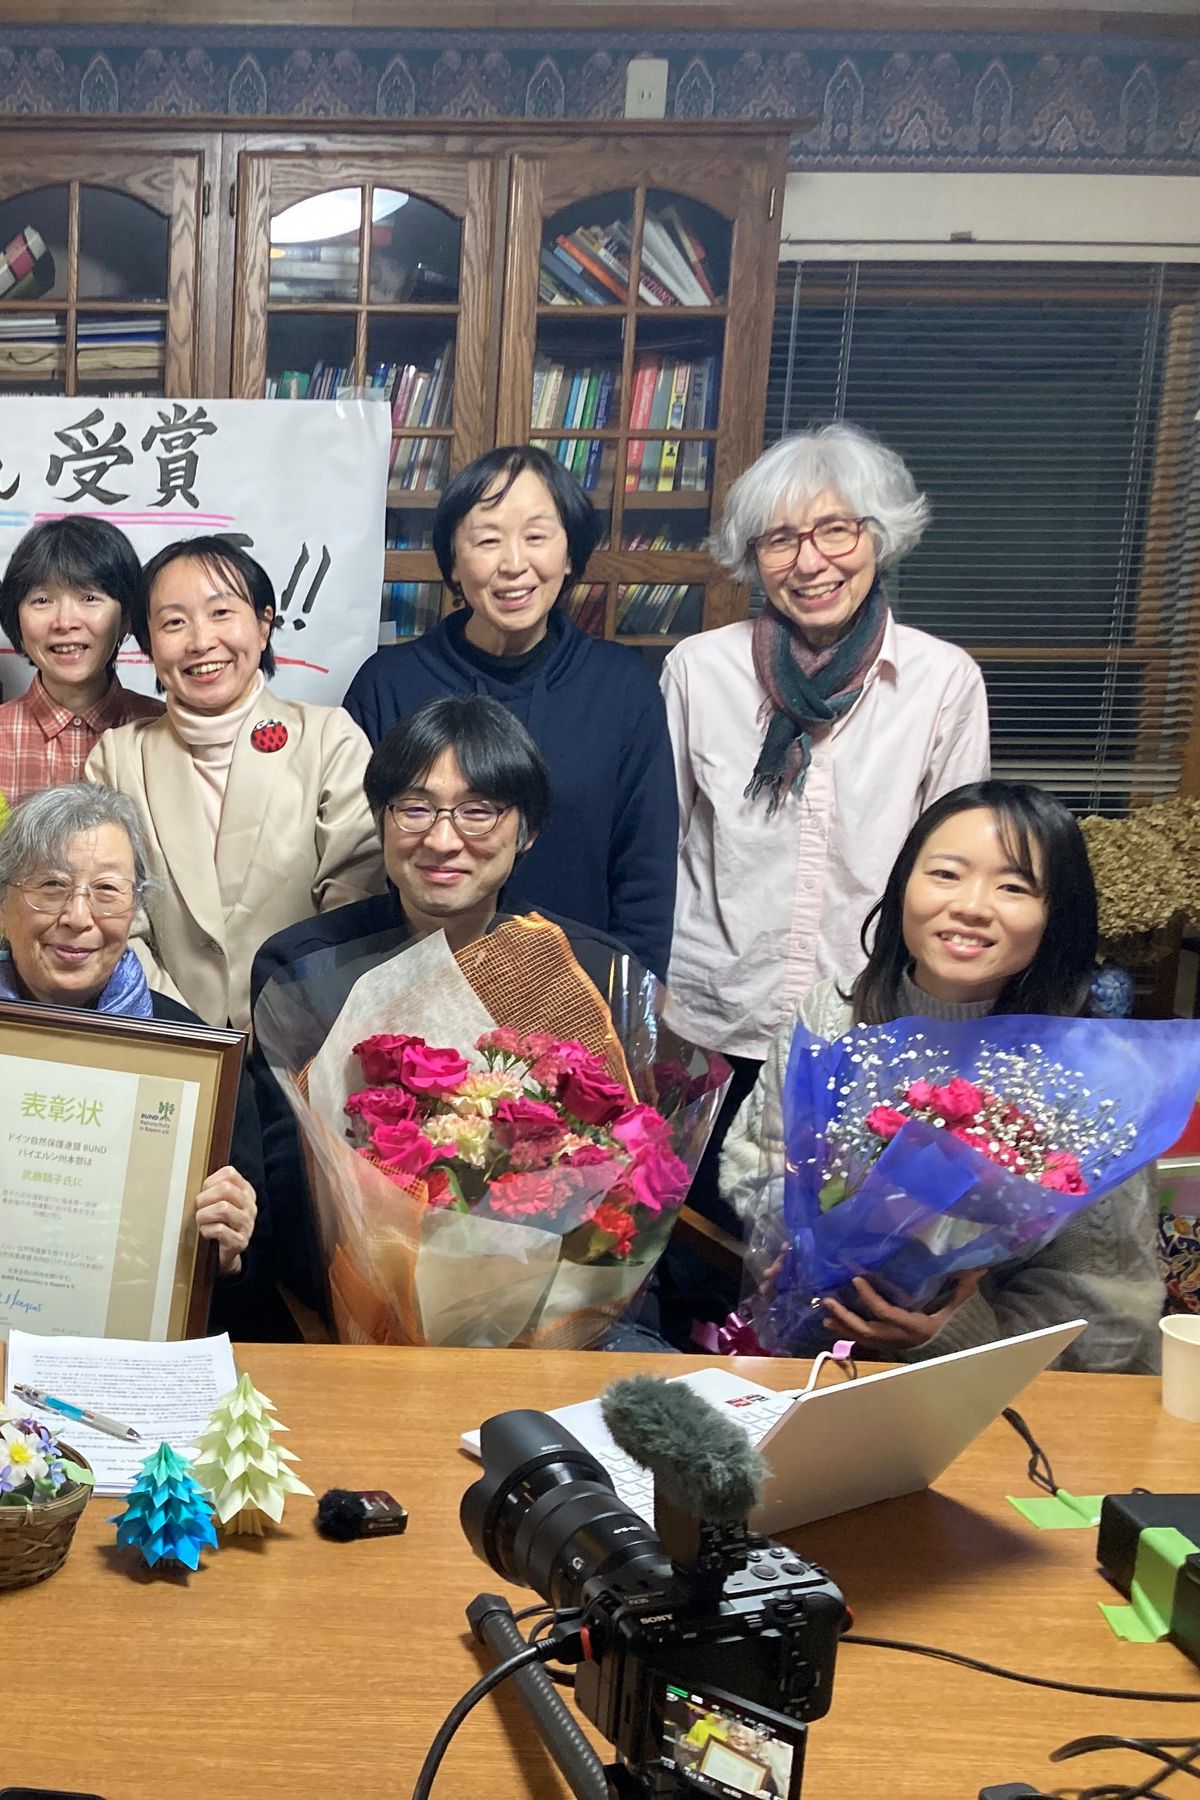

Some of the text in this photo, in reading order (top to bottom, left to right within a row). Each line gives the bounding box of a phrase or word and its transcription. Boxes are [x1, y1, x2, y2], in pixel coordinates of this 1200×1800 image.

[46, 403, 217, 508] 受賞
[21, 1091, 104, 1127] 表彰状
[640, 1613, 673, 1625] SONY
